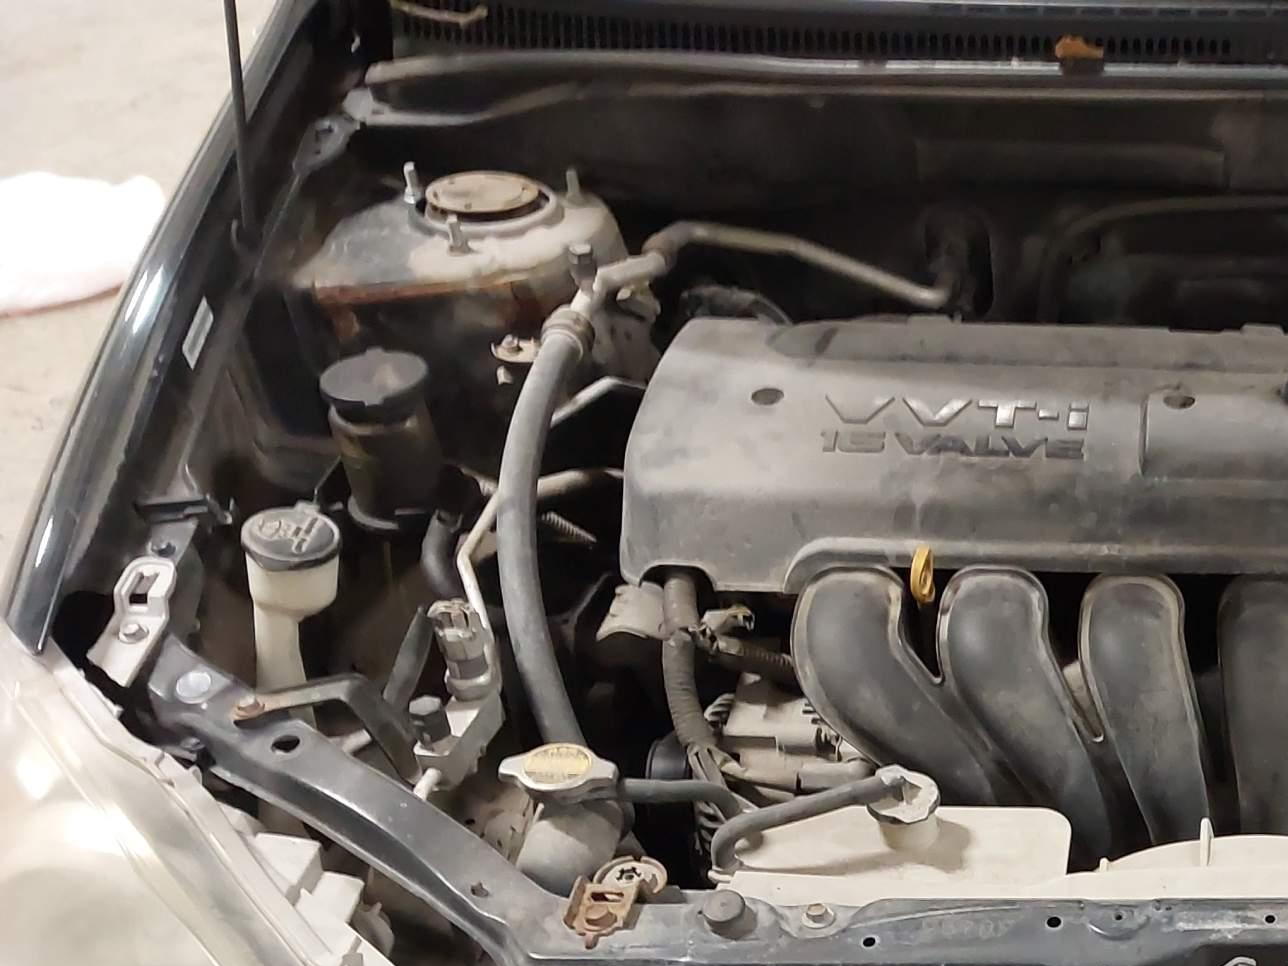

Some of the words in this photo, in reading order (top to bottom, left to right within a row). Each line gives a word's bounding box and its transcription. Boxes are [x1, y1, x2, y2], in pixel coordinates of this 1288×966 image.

[824, 395, 1091, 430] VVT-i
[820, 431, 886, 454] 16
[895, 432, 1086, 460] VALVE
